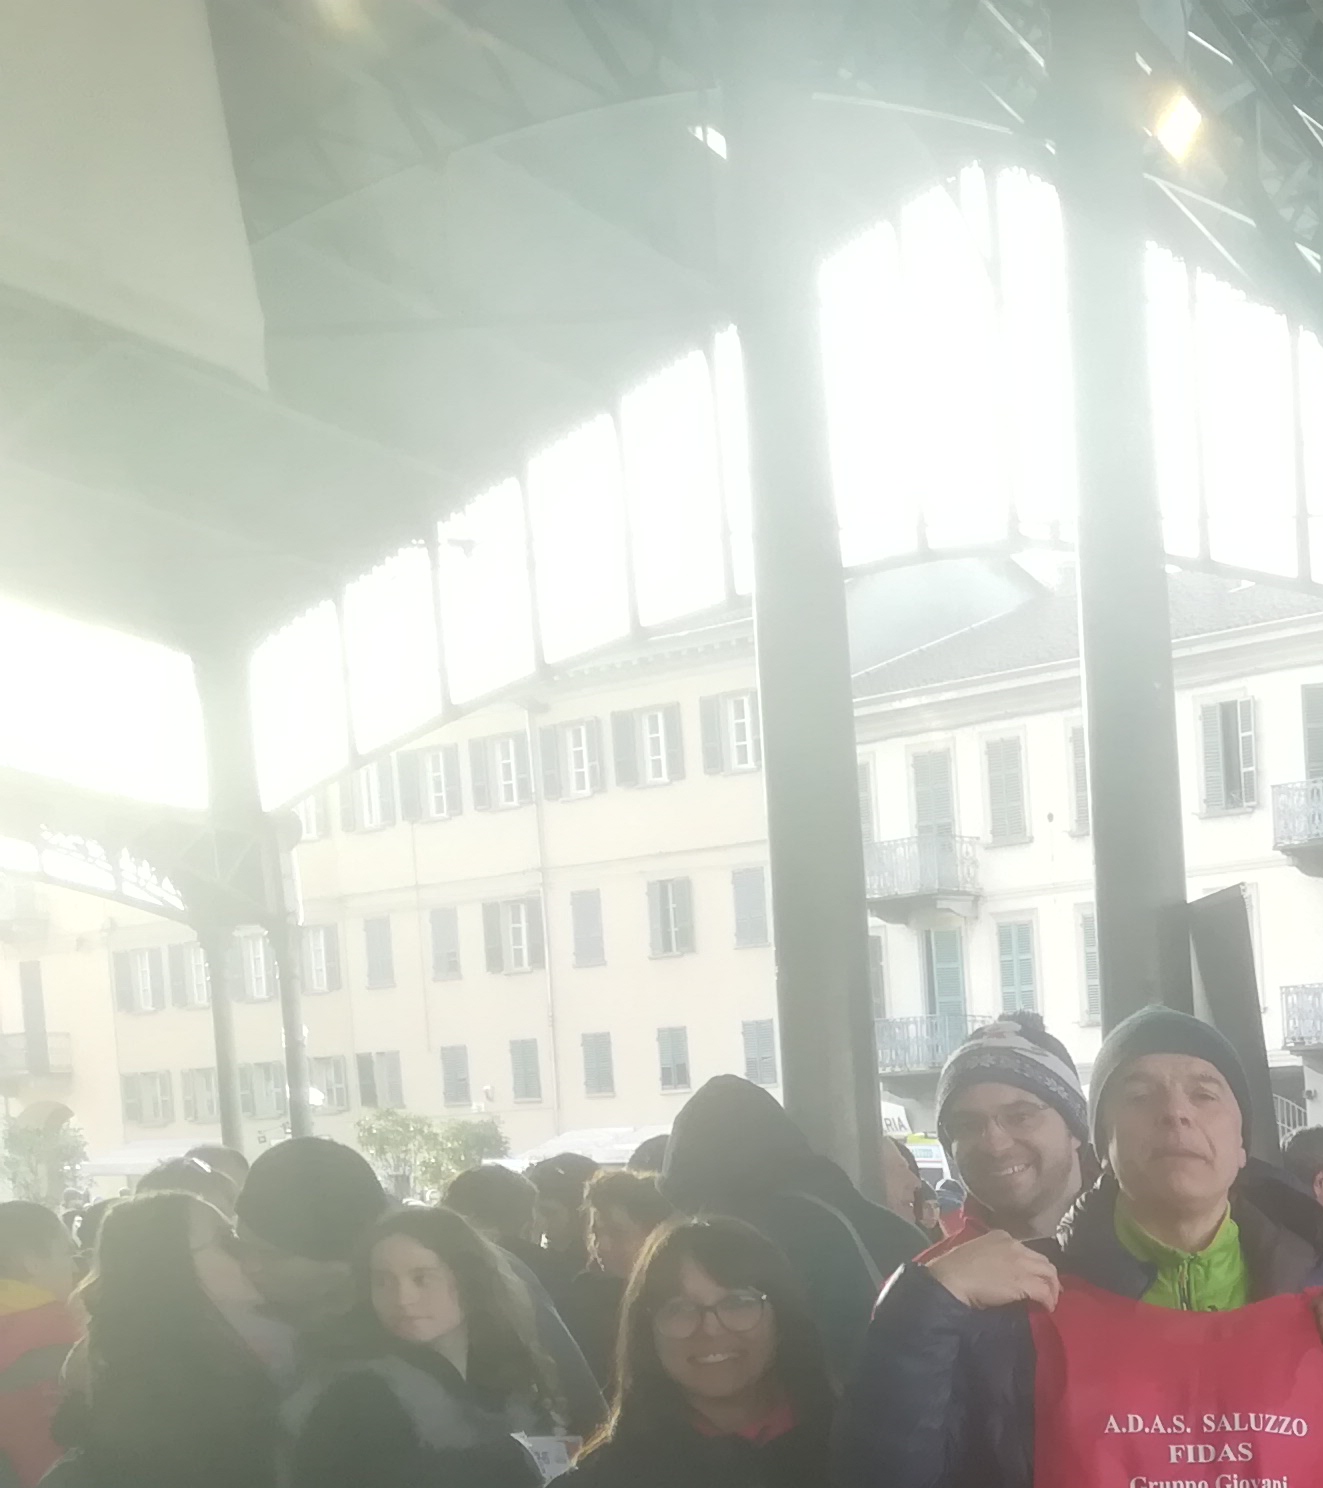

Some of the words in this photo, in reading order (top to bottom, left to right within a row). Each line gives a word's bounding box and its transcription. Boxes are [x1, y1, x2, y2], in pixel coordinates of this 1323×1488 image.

[1104, 1414, 1192, 1434] A.D.A.S.
[1202, 1412, 1308, 1437] SALUZZO
[1168, 1442, 1253, 1464] FIDAS
